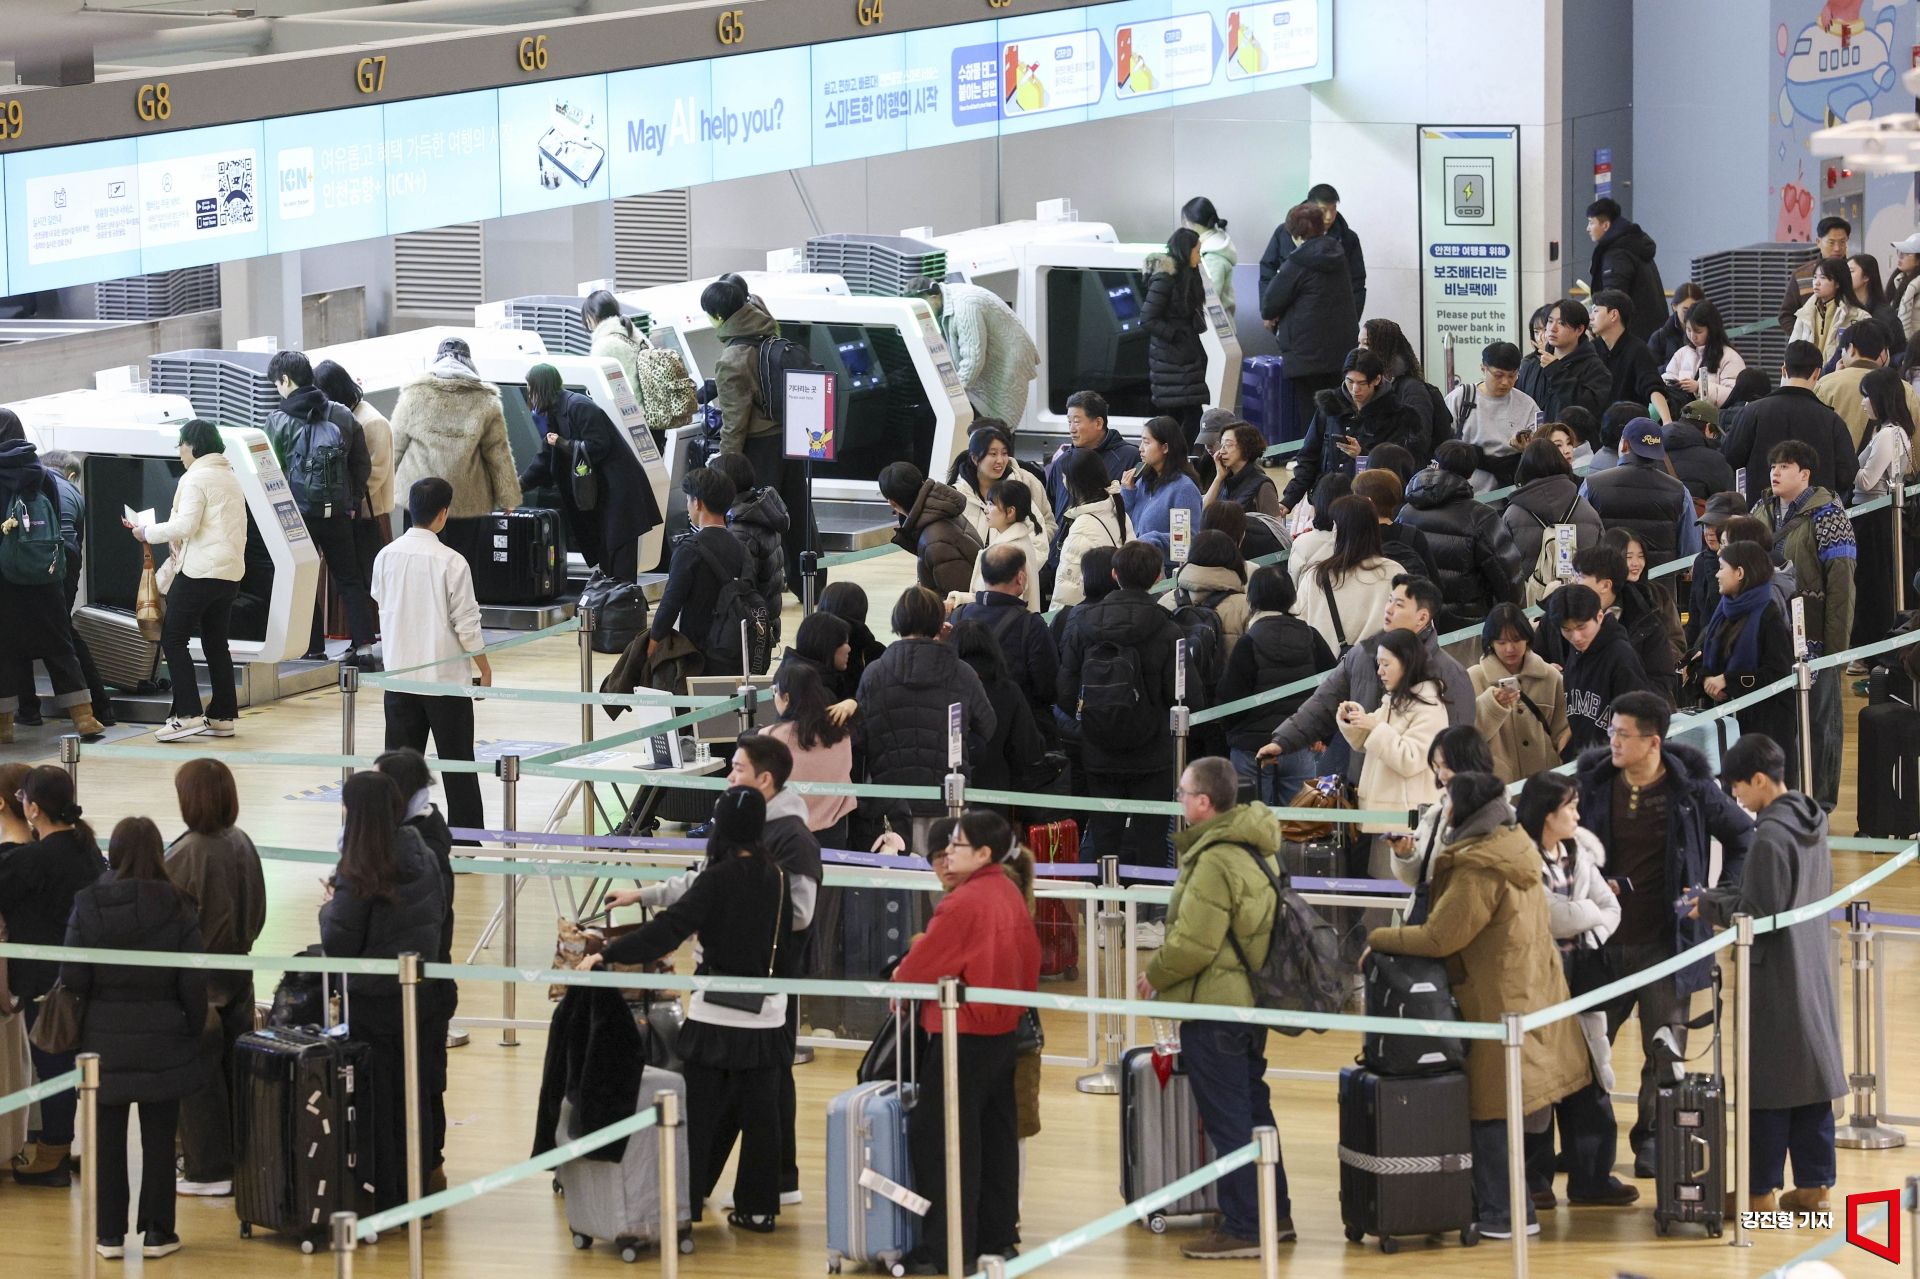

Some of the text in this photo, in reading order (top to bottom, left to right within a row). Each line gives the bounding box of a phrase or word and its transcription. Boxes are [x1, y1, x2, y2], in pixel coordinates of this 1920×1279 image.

[857, 0, 885, 27] G4
[717, 10, 745, 45] G5
[518, 34, 548, 71] G6
[357, 56, 387, 93] G7
[958, 60, 998, 83] 수하물 태그
[138, 83, 172, 121] G8
[959, 79, 998, 102] 붙이는 방법
[825, 86, 938, 129] 스마트한 여행의 시작
[627, 95, 785, 157] May AI help you?
[320, 143, 373, 174] 여유롭고
[377, 136, 403, 165] 혜택
[407, 131, 445, 162] 가득한
[448, 125, 486, 156] 여행의
[387, 168, 427, 200] (ICN+)
[1434, 245, 1507, 257] 안전한 여행을 위해
[1434, 265, 1508, 279] 보조배터리는
[1444, 283, 1497, 296] 비닐팩에!
[1436, 310, 1506, 321] Please put the
[1437, 322, 1506, 333] power bank in
[789, 385, 817, 394] 기다리는 곳
